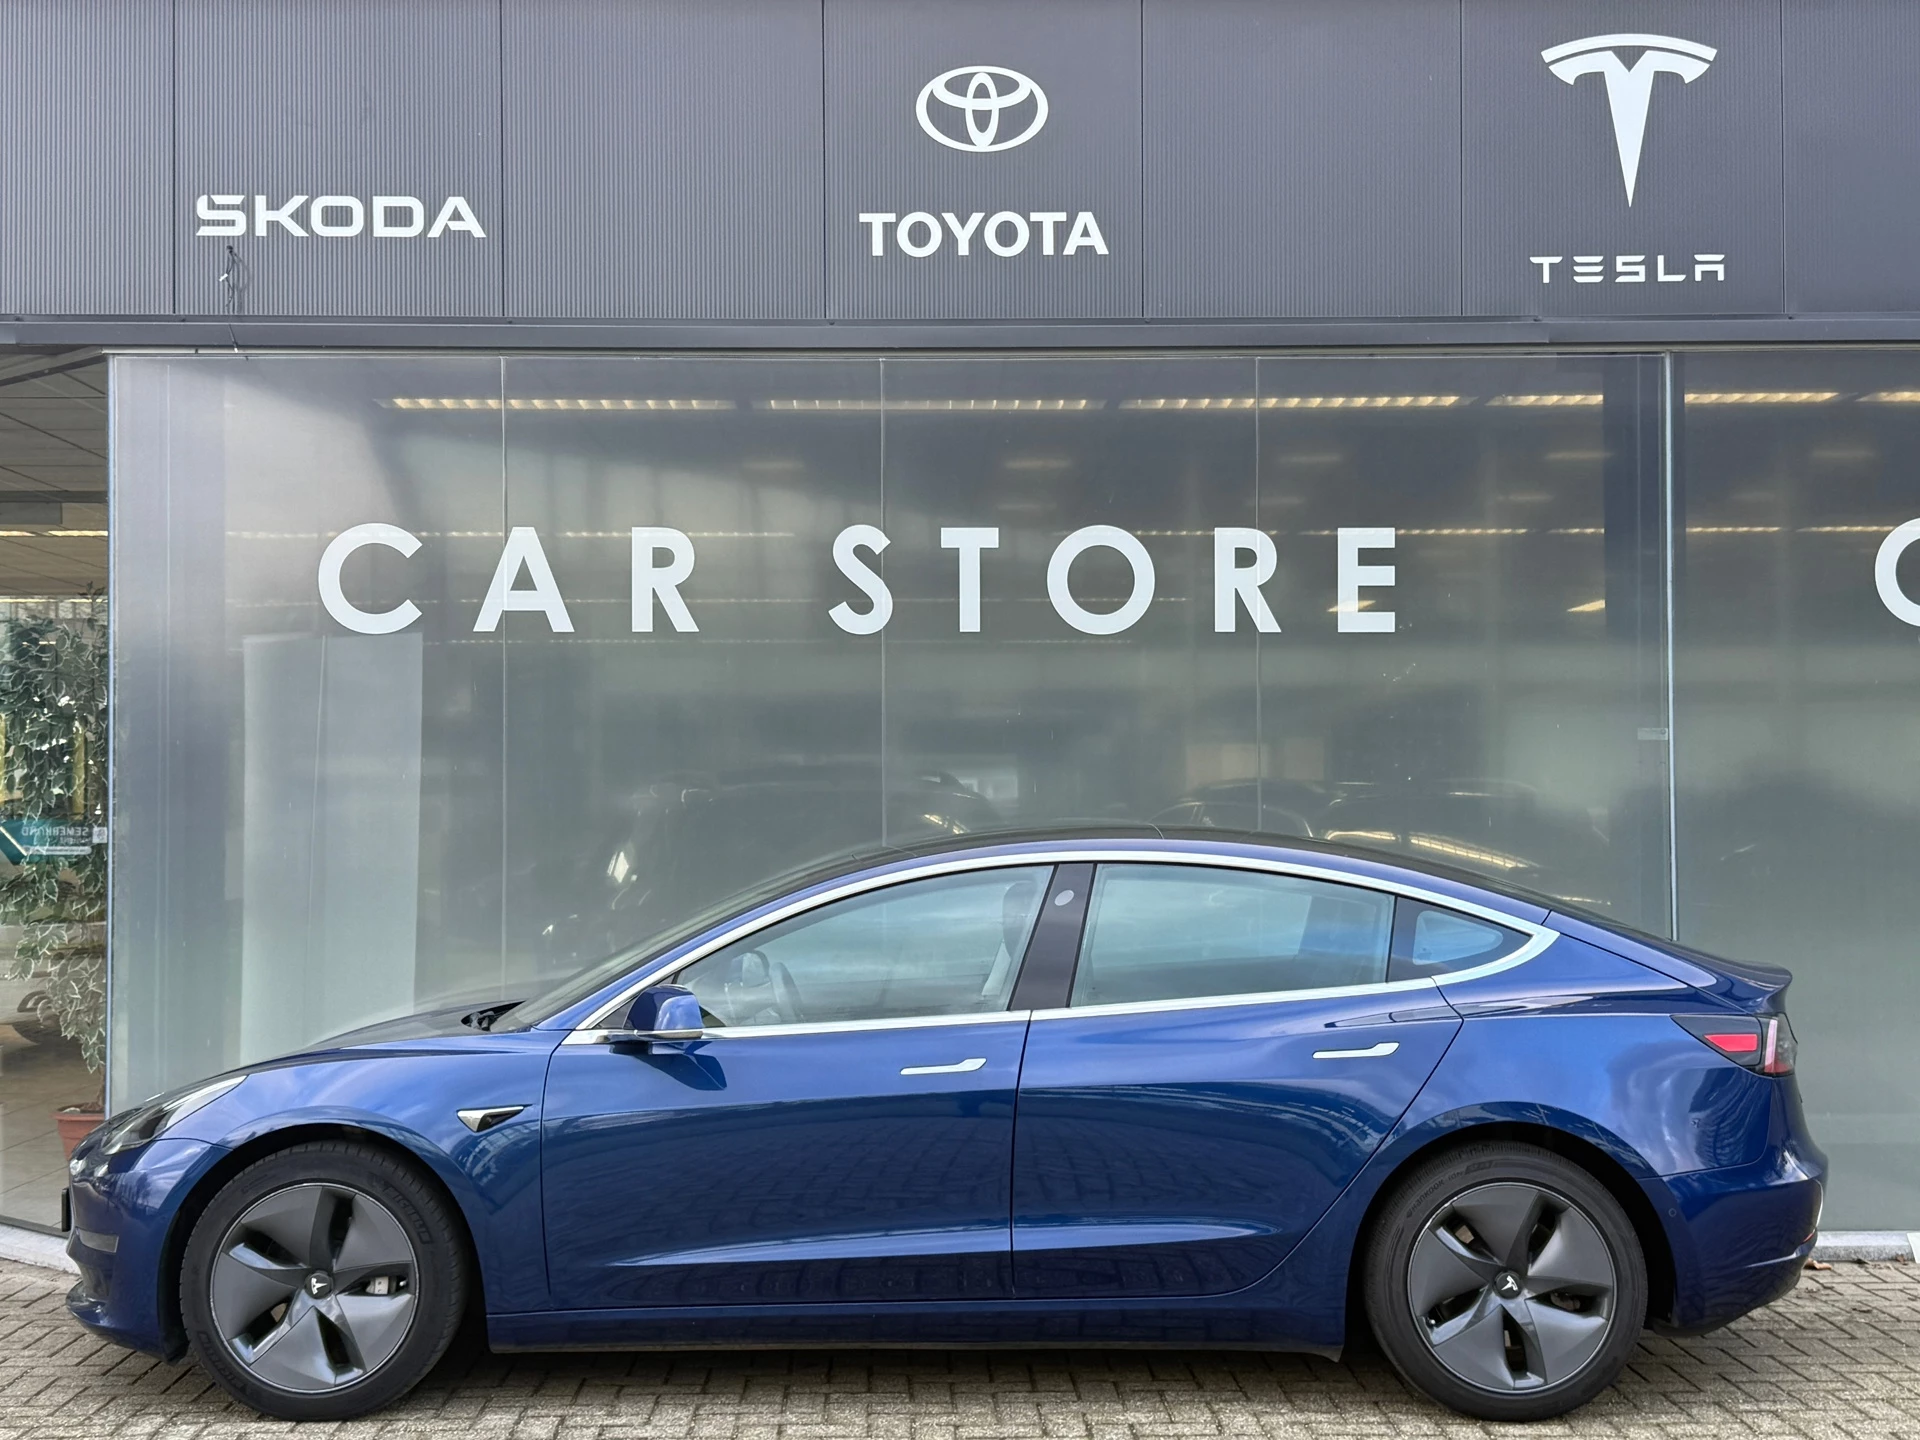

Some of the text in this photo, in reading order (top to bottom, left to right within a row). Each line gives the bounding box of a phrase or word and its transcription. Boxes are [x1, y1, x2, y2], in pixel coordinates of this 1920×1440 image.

[196, 194, 486, 238] SKODA
[859, 211, 1108, 258] TOYOTA
[1530, 254, 1725, 284] TESLA
[318, 523, 1396, 635] CAR STORE
